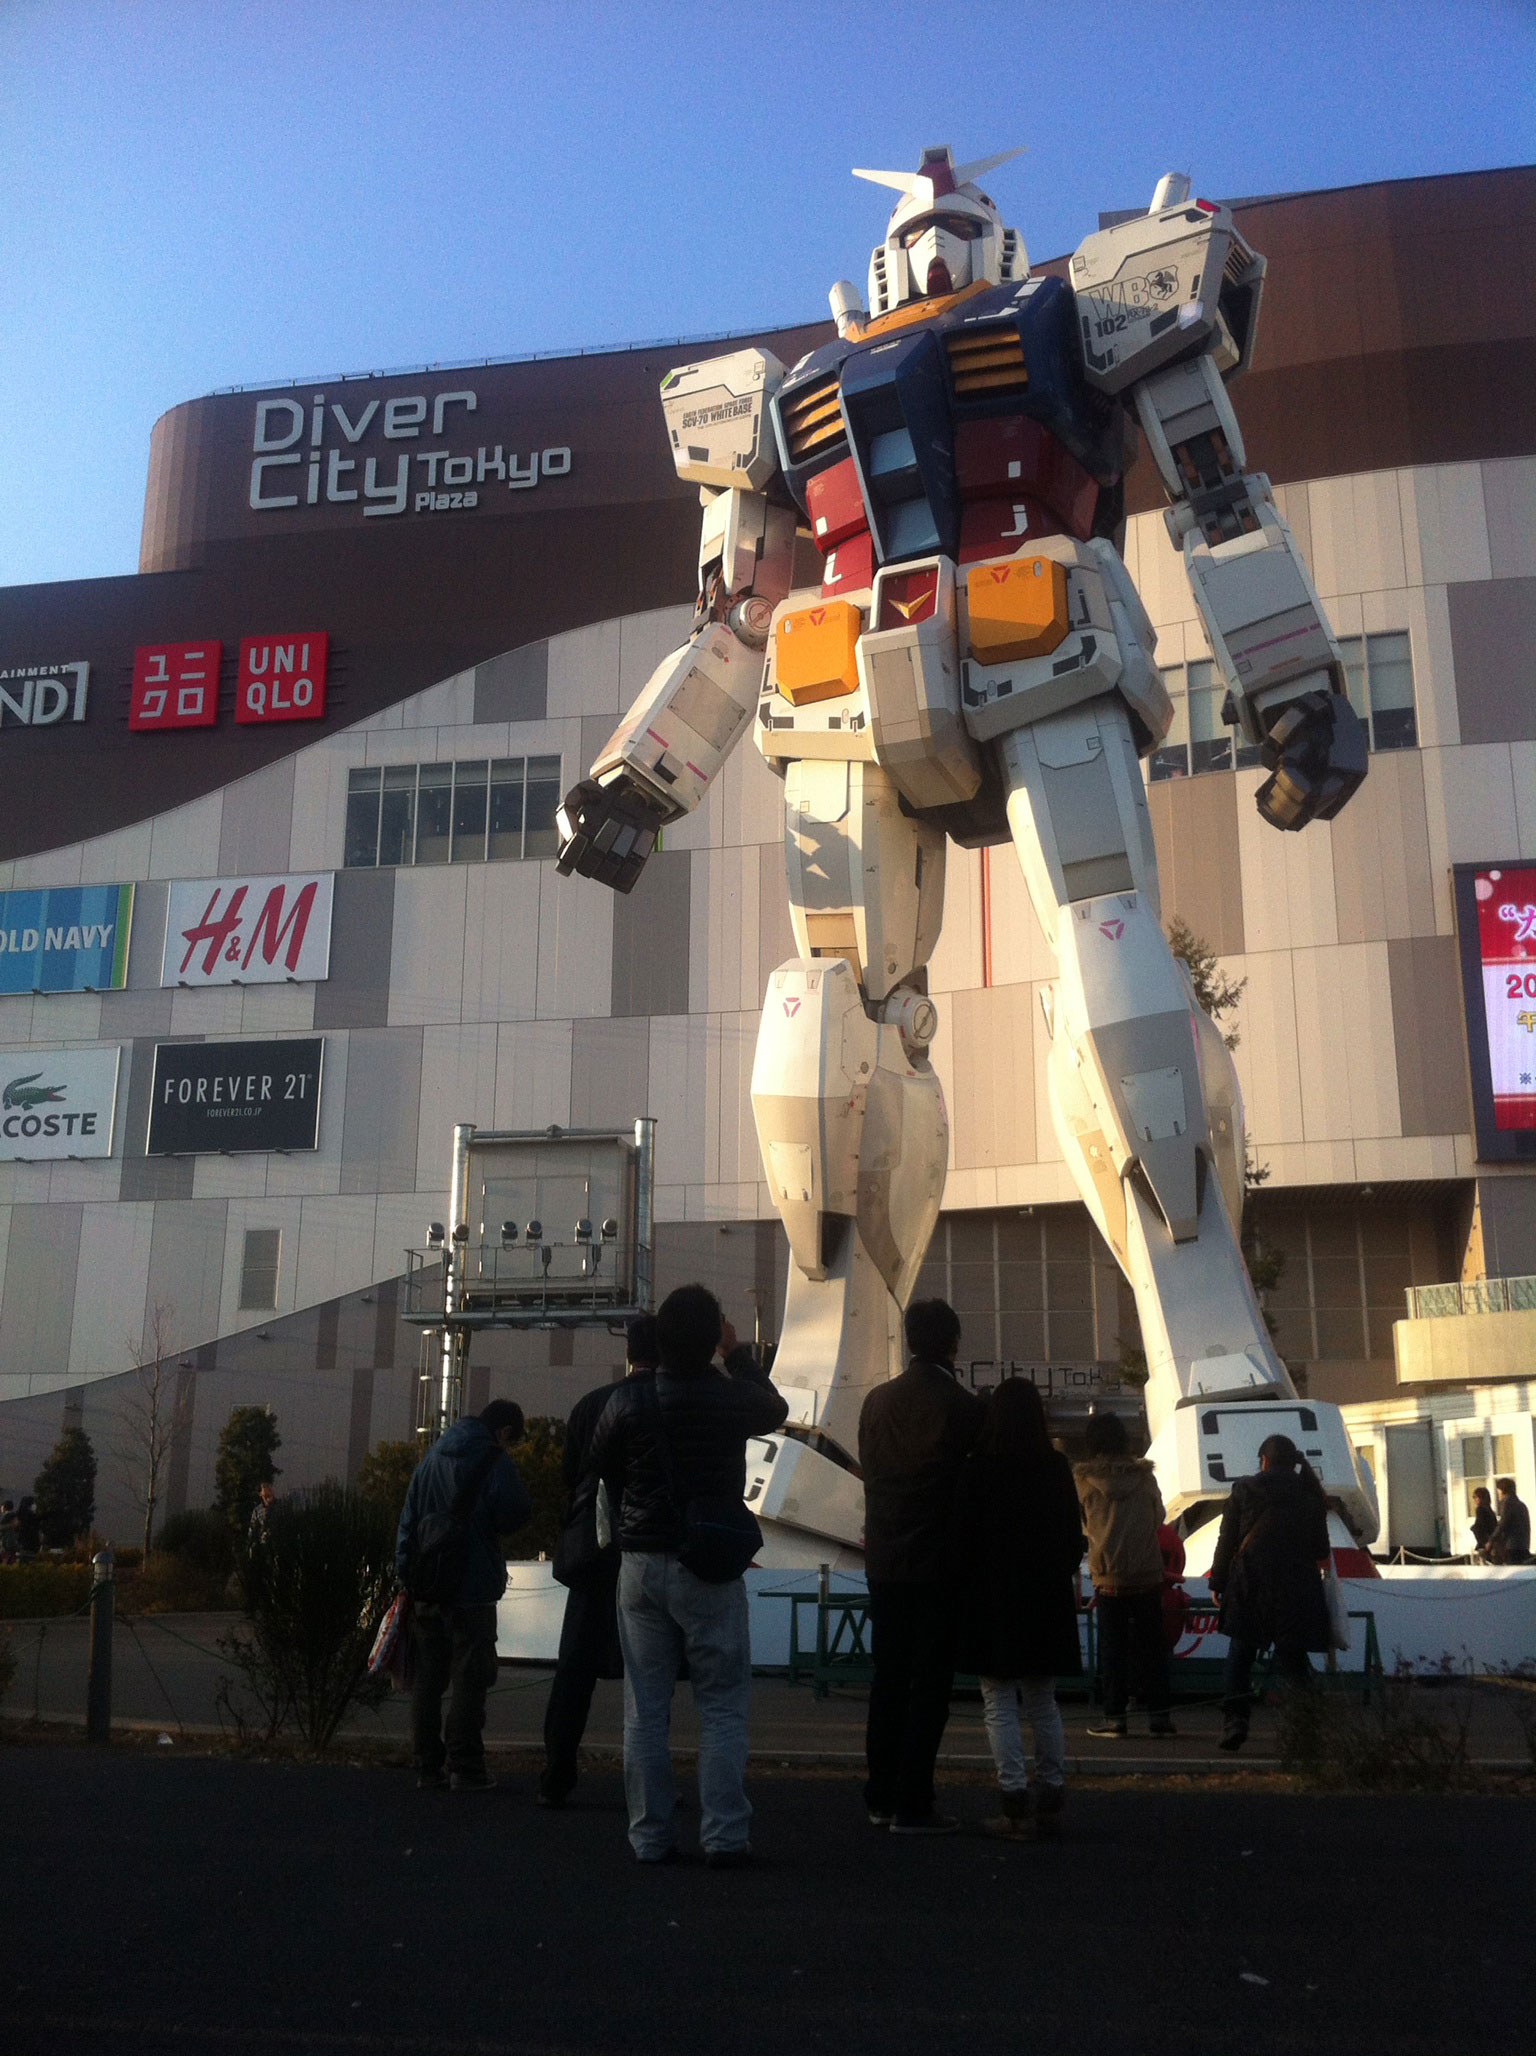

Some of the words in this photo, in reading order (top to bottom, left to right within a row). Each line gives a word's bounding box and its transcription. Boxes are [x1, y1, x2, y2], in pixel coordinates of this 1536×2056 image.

[1094, 315, 1128, 338] 102
[253, 390, 478, 452] Diver
[682, 415, 709, 429] SCV-70
[250, 448, 410, 517] City
[416, 445, 572, 489] Tokyo
[414, 491, 478, 512] Plaza
[145, 651, 206, 683] ユニ
[249, 643, 310, 676] UNI
[139, 686, 205, 718] クロ
[246, 678, 313, 716] QLO
[44, 924, 114, 951] NAVY
[179, 880, 318, 976] H&M
[164, 1075, 273, 1104] FOREVER
